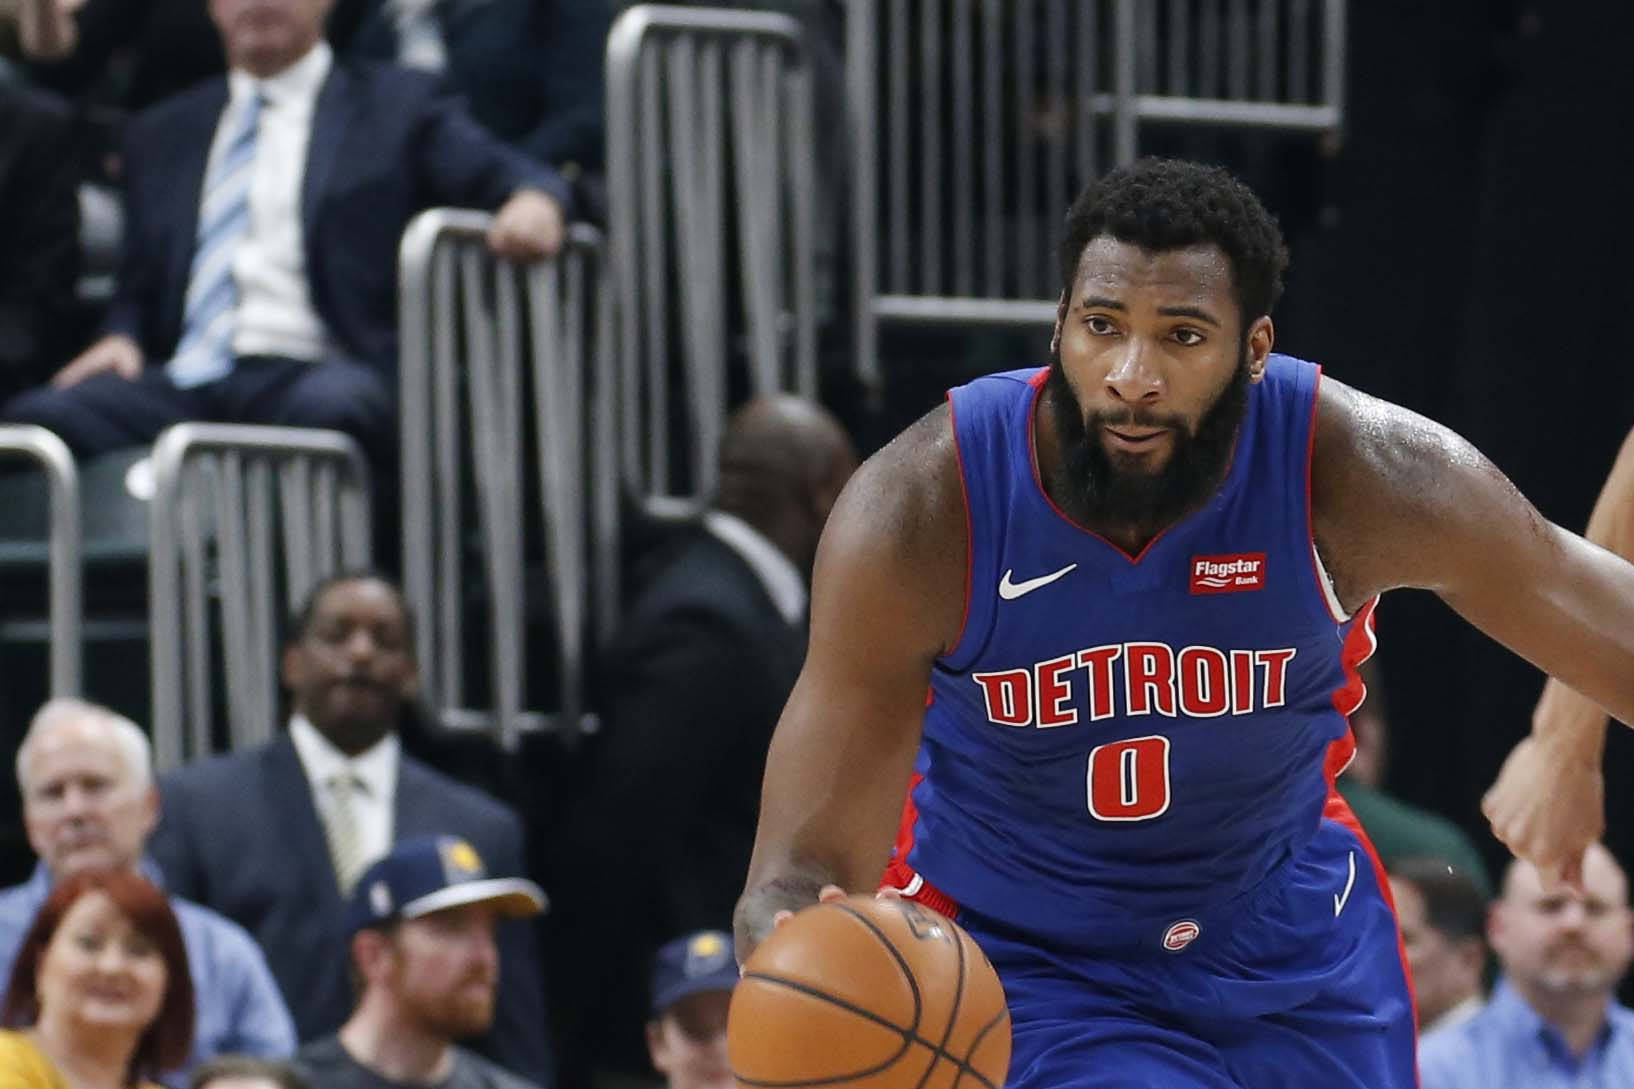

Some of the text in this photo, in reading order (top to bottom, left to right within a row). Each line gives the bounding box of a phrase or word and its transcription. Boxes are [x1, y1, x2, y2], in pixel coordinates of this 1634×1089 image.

[1195, 560, 1261, 577] Flagstar
[1235, 575, 1259, 585] Bank
[972, 641, 1297, 728] DETROIT
[1087, 734, 1171, 822] 0
